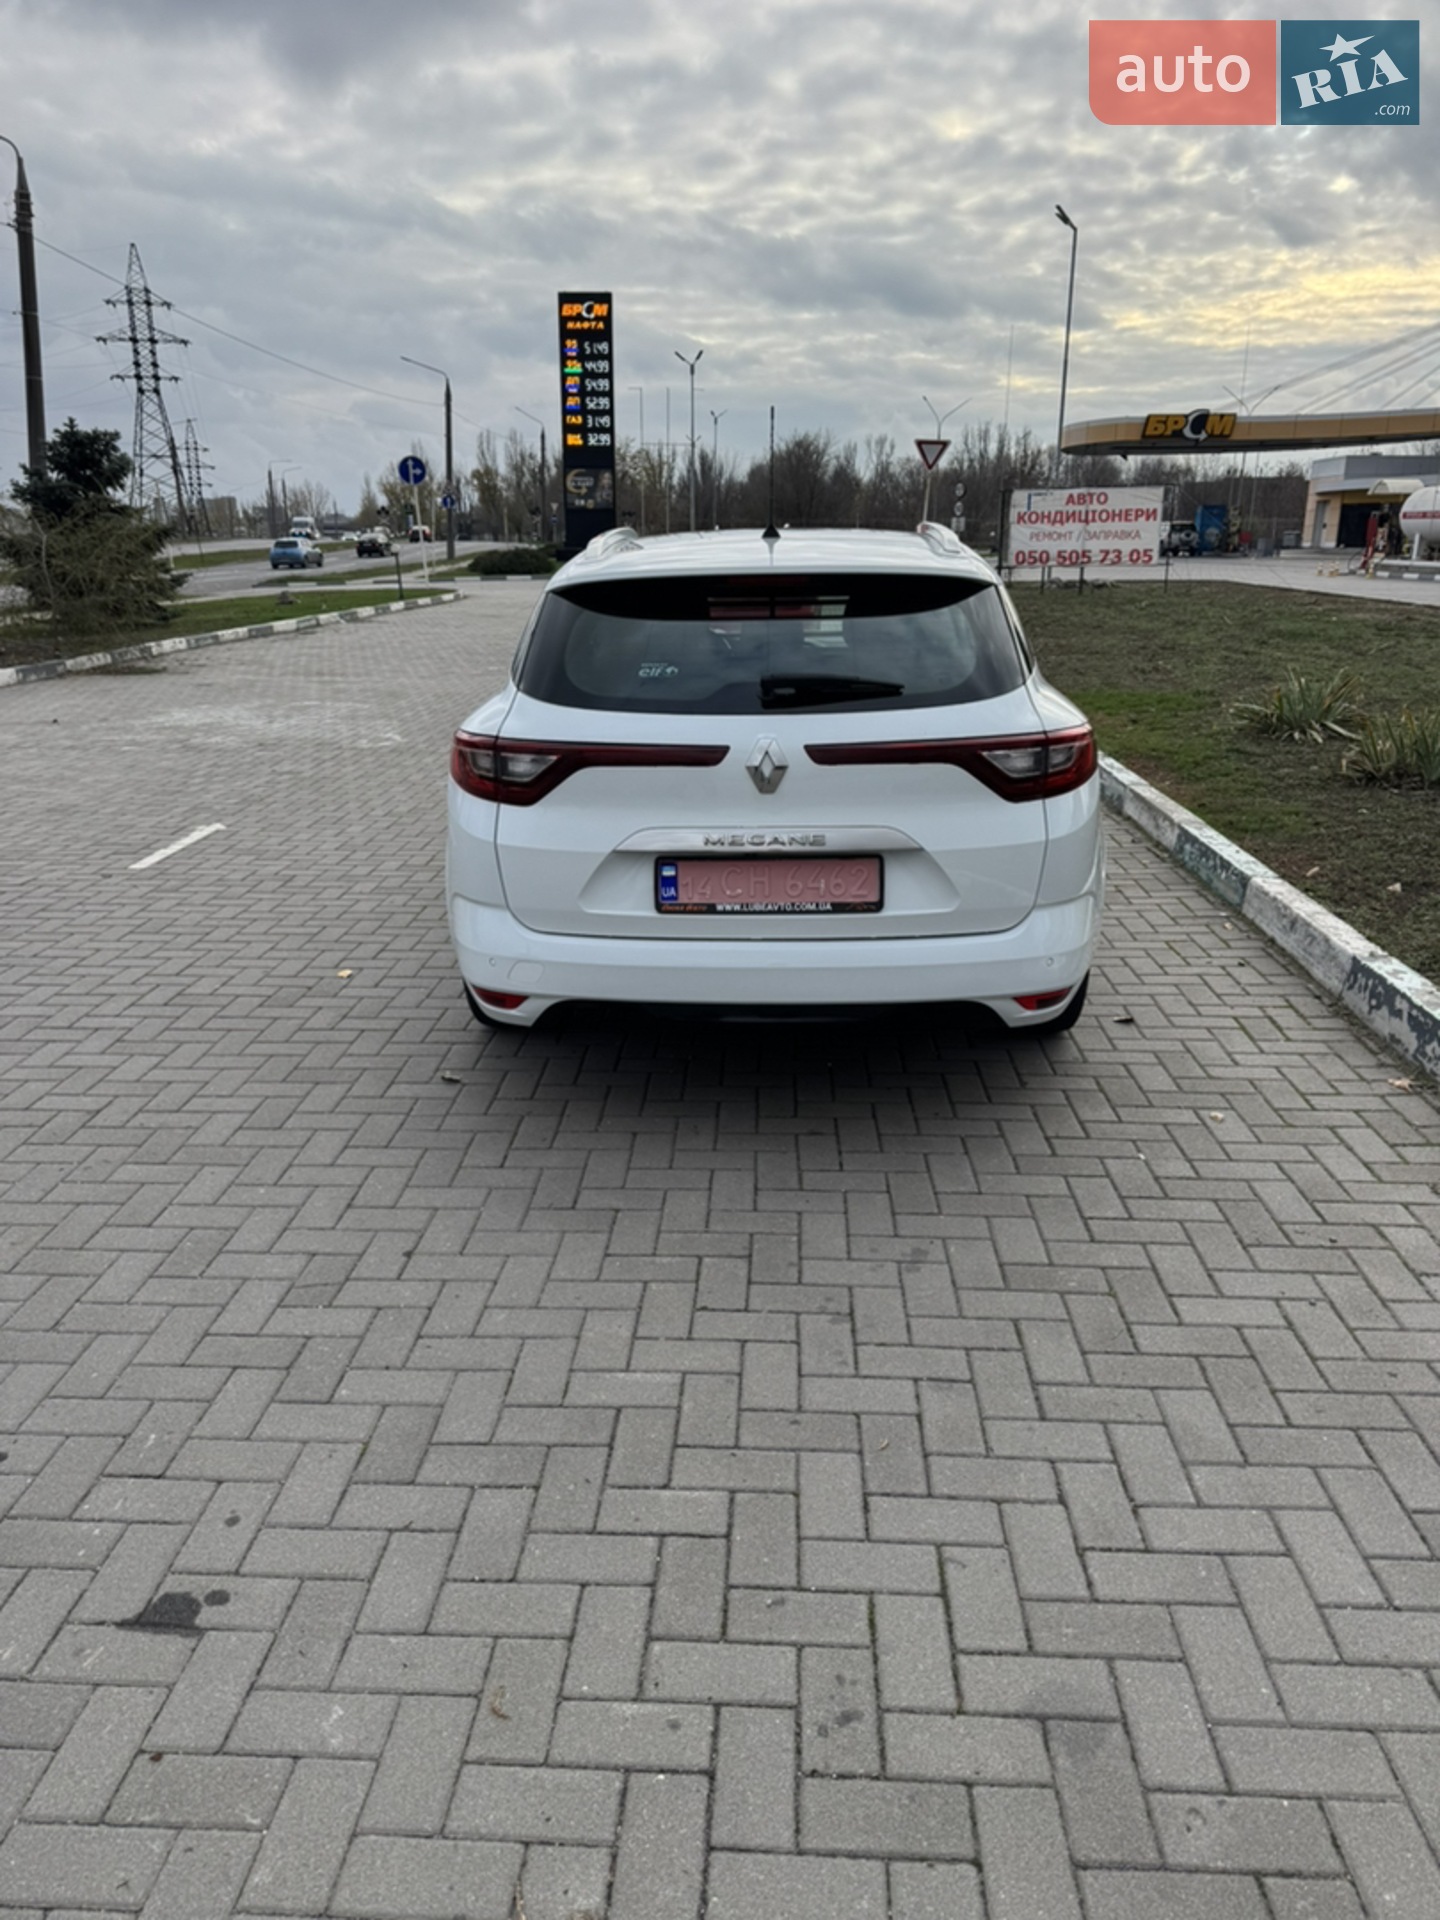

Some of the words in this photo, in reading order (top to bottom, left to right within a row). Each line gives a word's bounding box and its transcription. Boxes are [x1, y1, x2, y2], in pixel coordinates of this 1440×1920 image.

[561, 300, 609, 319] БРСМ
[566, 320, 605, 330] НАФТА
[1143, 409, 1237, 440] БРСМ
[1065, 491, 1109, 505] АВТО
[1016, 508, 1158, 526] КОНДИЦІОНЕРИ
[1029, 531, 1074, 542] РЕМОНТ
[1084, 529, 1142, 541] ЗАПРАВКА
[1014, 550, 1050, 566] 050
[1056, 550, 1092, 565] 505
[1099, 549, 1122, 564] 73
[1128, 549, 1153, 564] 05
[703, 833, 826, 847] MEGANE
[786, 865, 869, 897] 6462
[661, 886, 677, 898] UA
